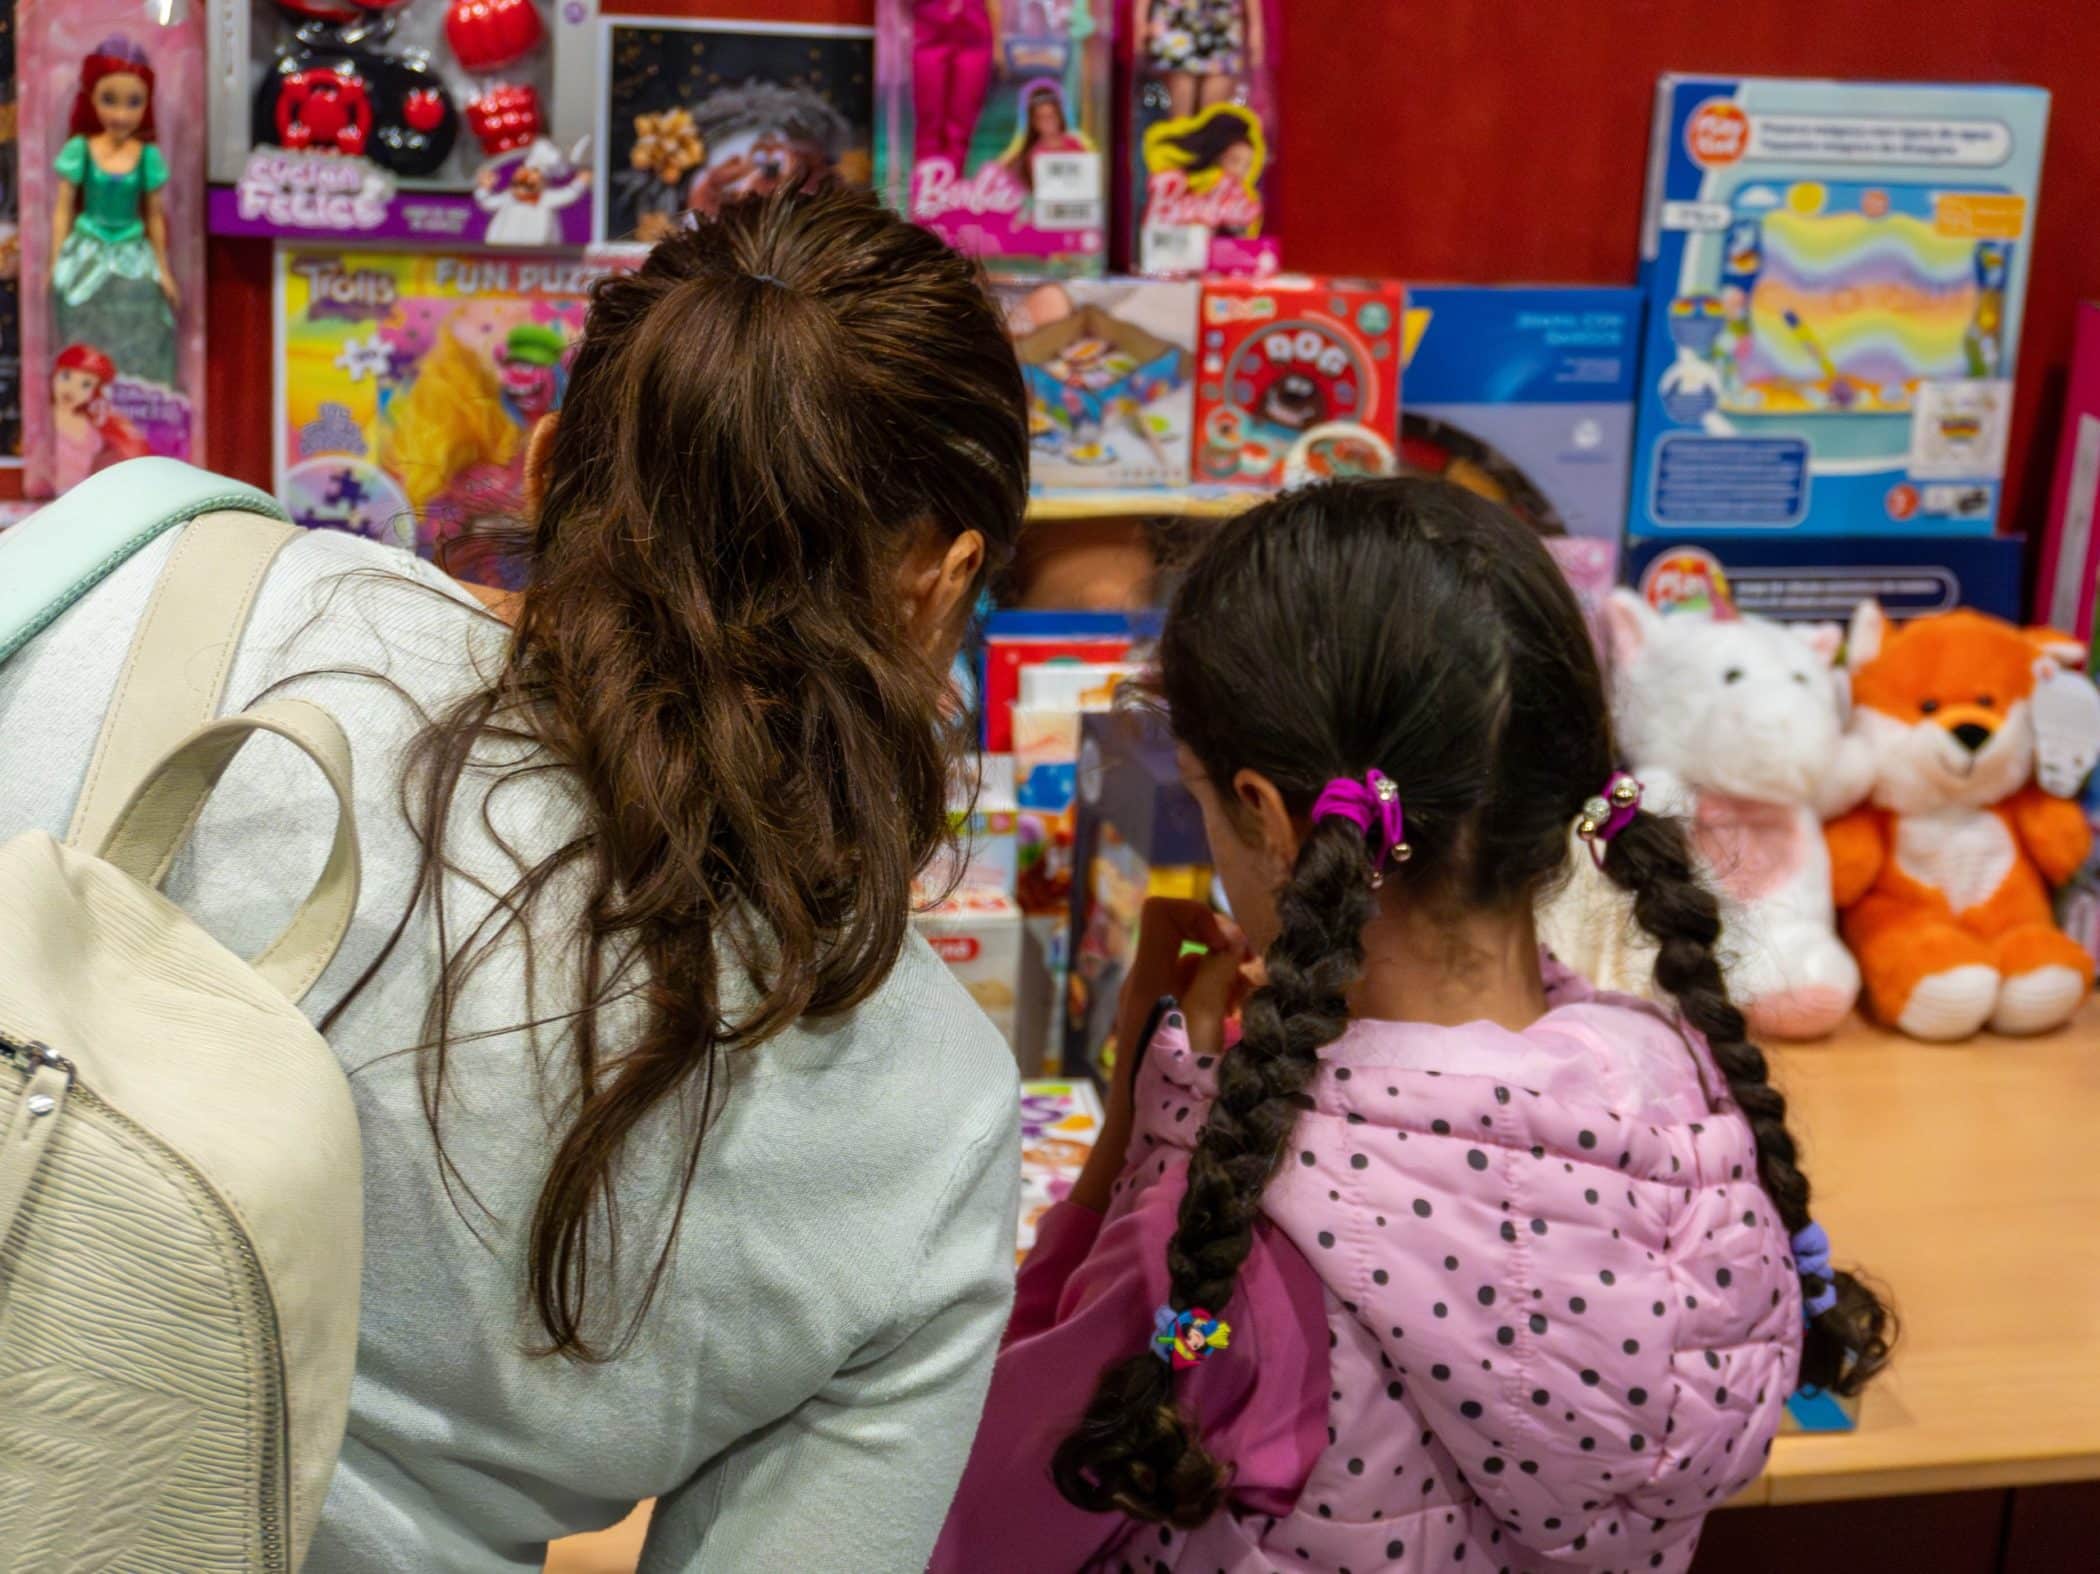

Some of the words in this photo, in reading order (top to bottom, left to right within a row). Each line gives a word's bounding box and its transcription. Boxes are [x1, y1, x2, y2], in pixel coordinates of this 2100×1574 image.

[915, 158, 1023, 216] Barbie
[294, 257, 396, 304] Trolls
[436, 258, 508, 294] FUN
